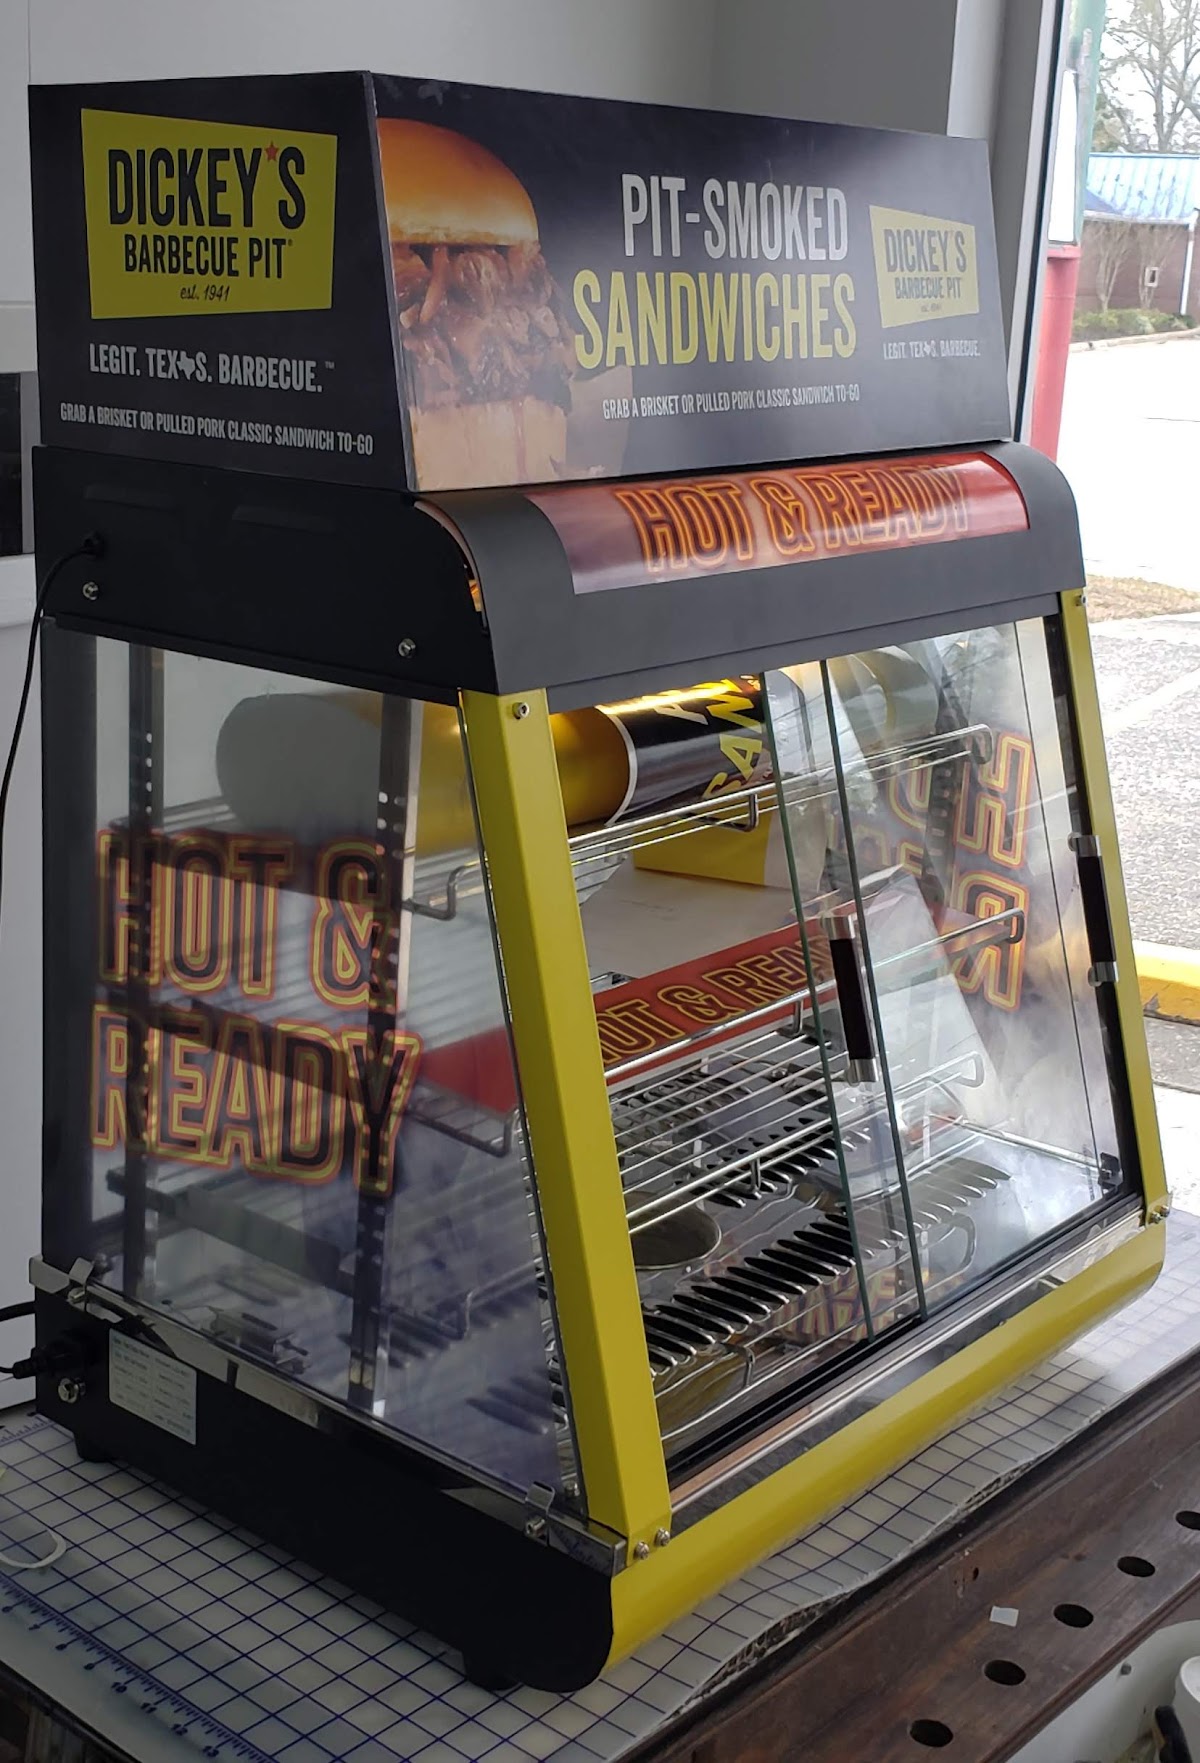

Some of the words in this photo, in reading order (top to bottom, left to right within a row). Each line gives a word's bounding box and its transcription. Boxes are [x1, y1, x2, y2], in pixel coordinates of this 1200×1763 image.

[108, 143, 306, 230] DICKEY'S
[621, 172, 848, 262] PIT-SMOKED
[124, 233, 240, 277] BARBECUE
[203, 284, 231, 302] 1941
[894, 276, 945, 300] BARBECUE
[946, 276, 962, 299] PIT
[572, 268, 858, 370] SANDWICHES
[89, 342, 141, 377] LEGIT.
[60, 402, 87, 423] GRAB
[88, 405, 96, 424] A
[97, 406, 139, 429] BRISKET
[139, 410, 154, 431] OR
[156, 412, 195, 435] PULLED
[197, 417, 226, 439] PORK
[227, 419, 273, 445] CLASSIC
[274, 424, 335, 451] SANDWICH
[336, 431, 374, 456] TO-GO
[602, 398, 630, 420] GRAB
[631, 397, 639, 417] A
[640, 395, 680, 417] BRISKET
[681, 394, 695, 414] OR
[696, 391, 730, 413] PULLED
[731, 390, 755, 410] PORK
[756, 388, 791, 409] CLASSIC
[791, 384, 835, 406] SANDWICH
[835, 383, 860, 402] TO-GO
[614, 479, 754, 573] HOT
[749, 475, 816, 556] &
[797, 463, 970, 549] READY
[97, 829, 295, 999] HOT
[310, 832, 397, 1013] &
[596, 998, 686, 1064] OT
[656, 984, 747, 1024] &
[89, 1001, 424, 1198] READY
